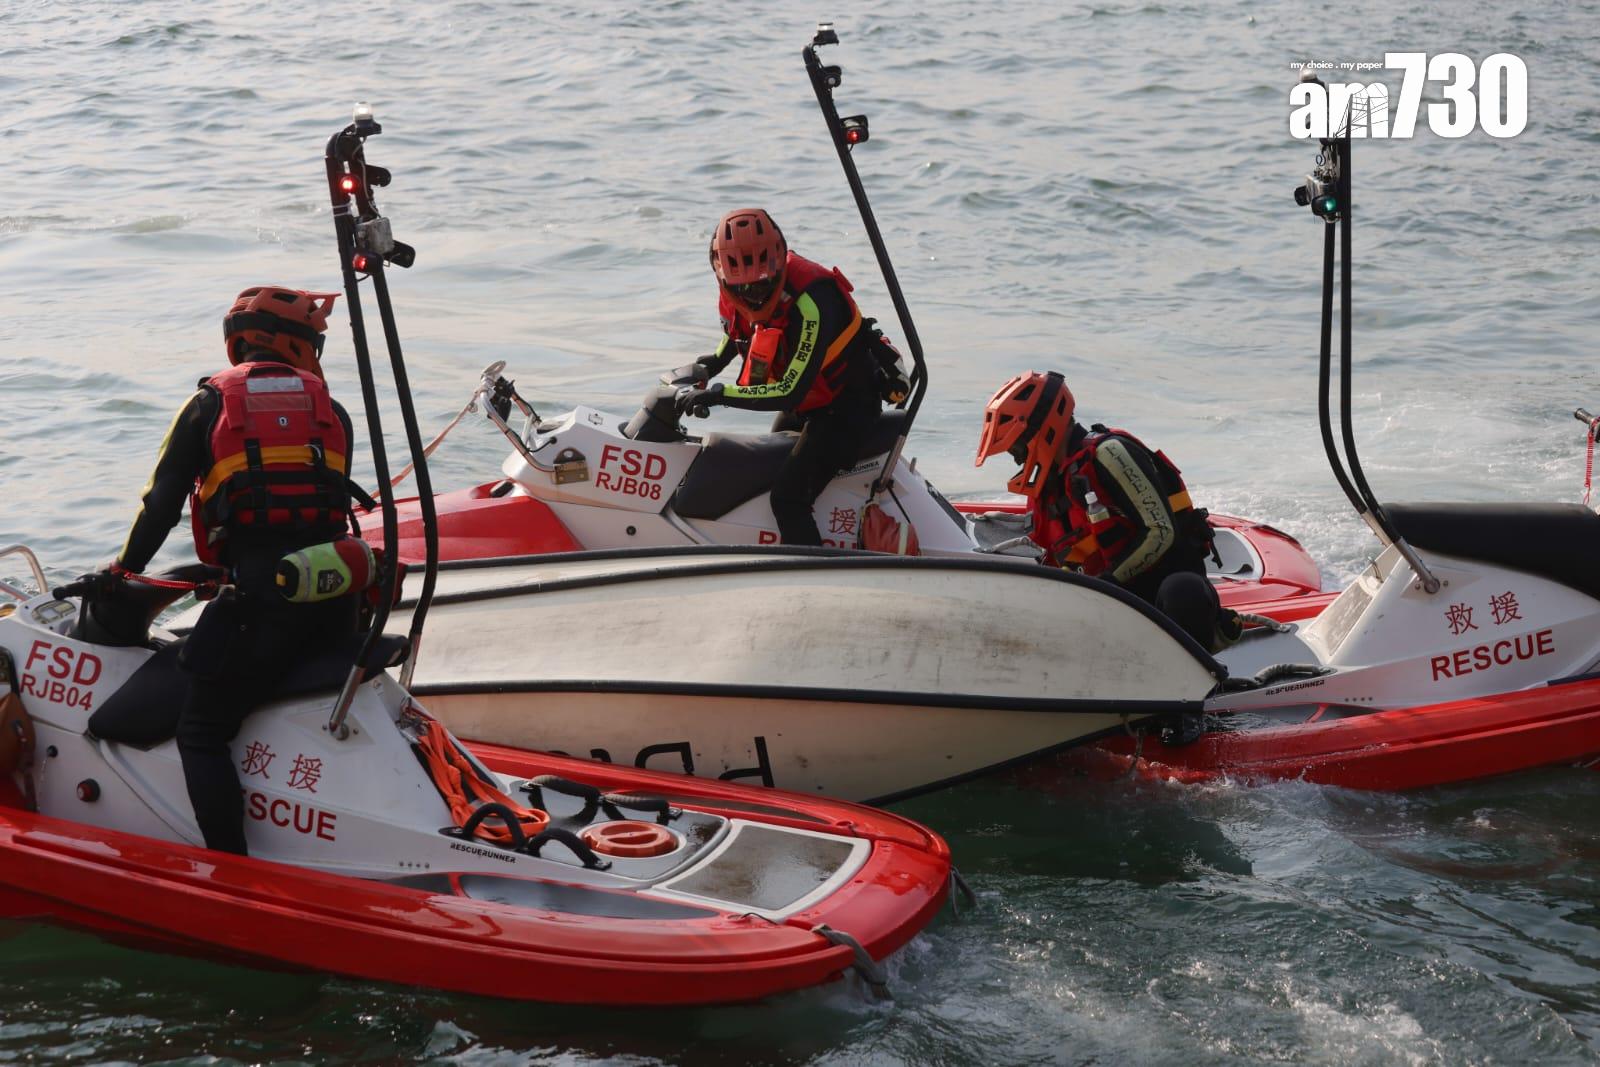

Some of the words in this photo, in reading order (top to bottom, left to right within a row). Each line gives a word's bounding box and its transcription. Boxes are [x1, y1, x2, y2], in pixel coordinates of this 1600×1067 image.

[797, 320, 818, 363] FIRE
[599, 444, 667, 481] FSD
[595, 471, 662, 501] RJB08
[1444, 590, 1524, 635] 救援
[24, 640, 102, 686] FSD
[1431, 629, 1556, 682] RESCUE
[20, 673, 93, 711] RJB04
[241, 740, 323, 794] 救援
[241, 788, 338, 842] SCUE
[449, 842, 517, 864] RESCUERUNNER
